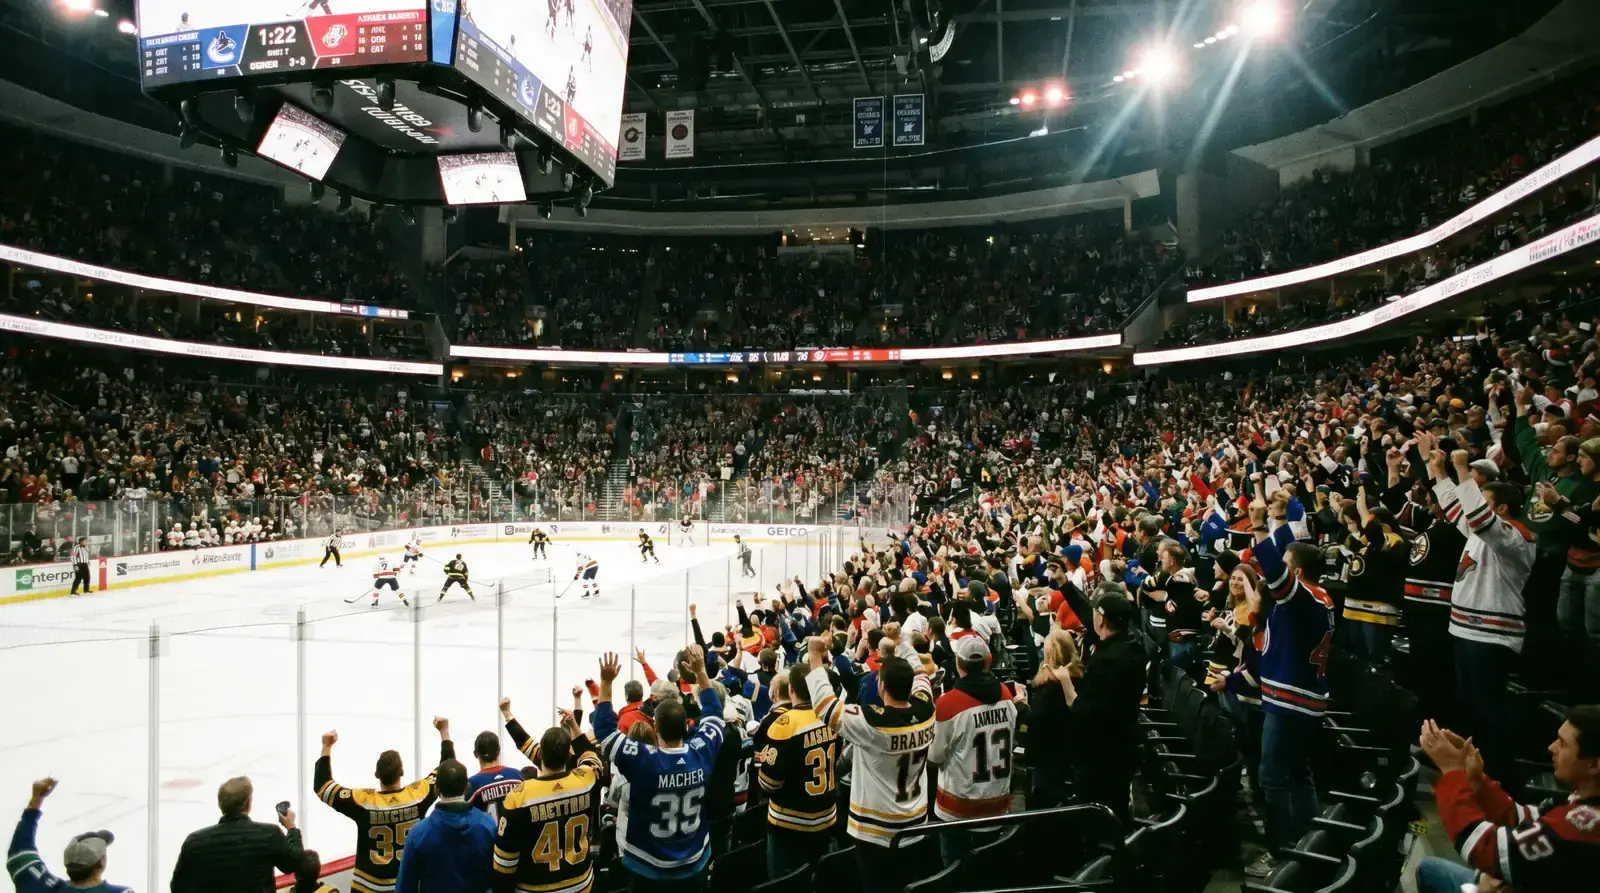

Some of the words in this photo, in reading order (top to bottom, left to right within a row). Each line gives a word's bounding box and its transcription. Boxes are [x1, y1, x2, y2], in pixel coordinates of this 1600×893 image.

[259, 25, 296, 46] 1:22
[767, 526, 807, 536] GEICO
[805, 743, 836, 796] 31
[972, 727, 1011, 784] 13
[658, 768, 705, 789] MACHER
[531, 813, 590, 872] 40
